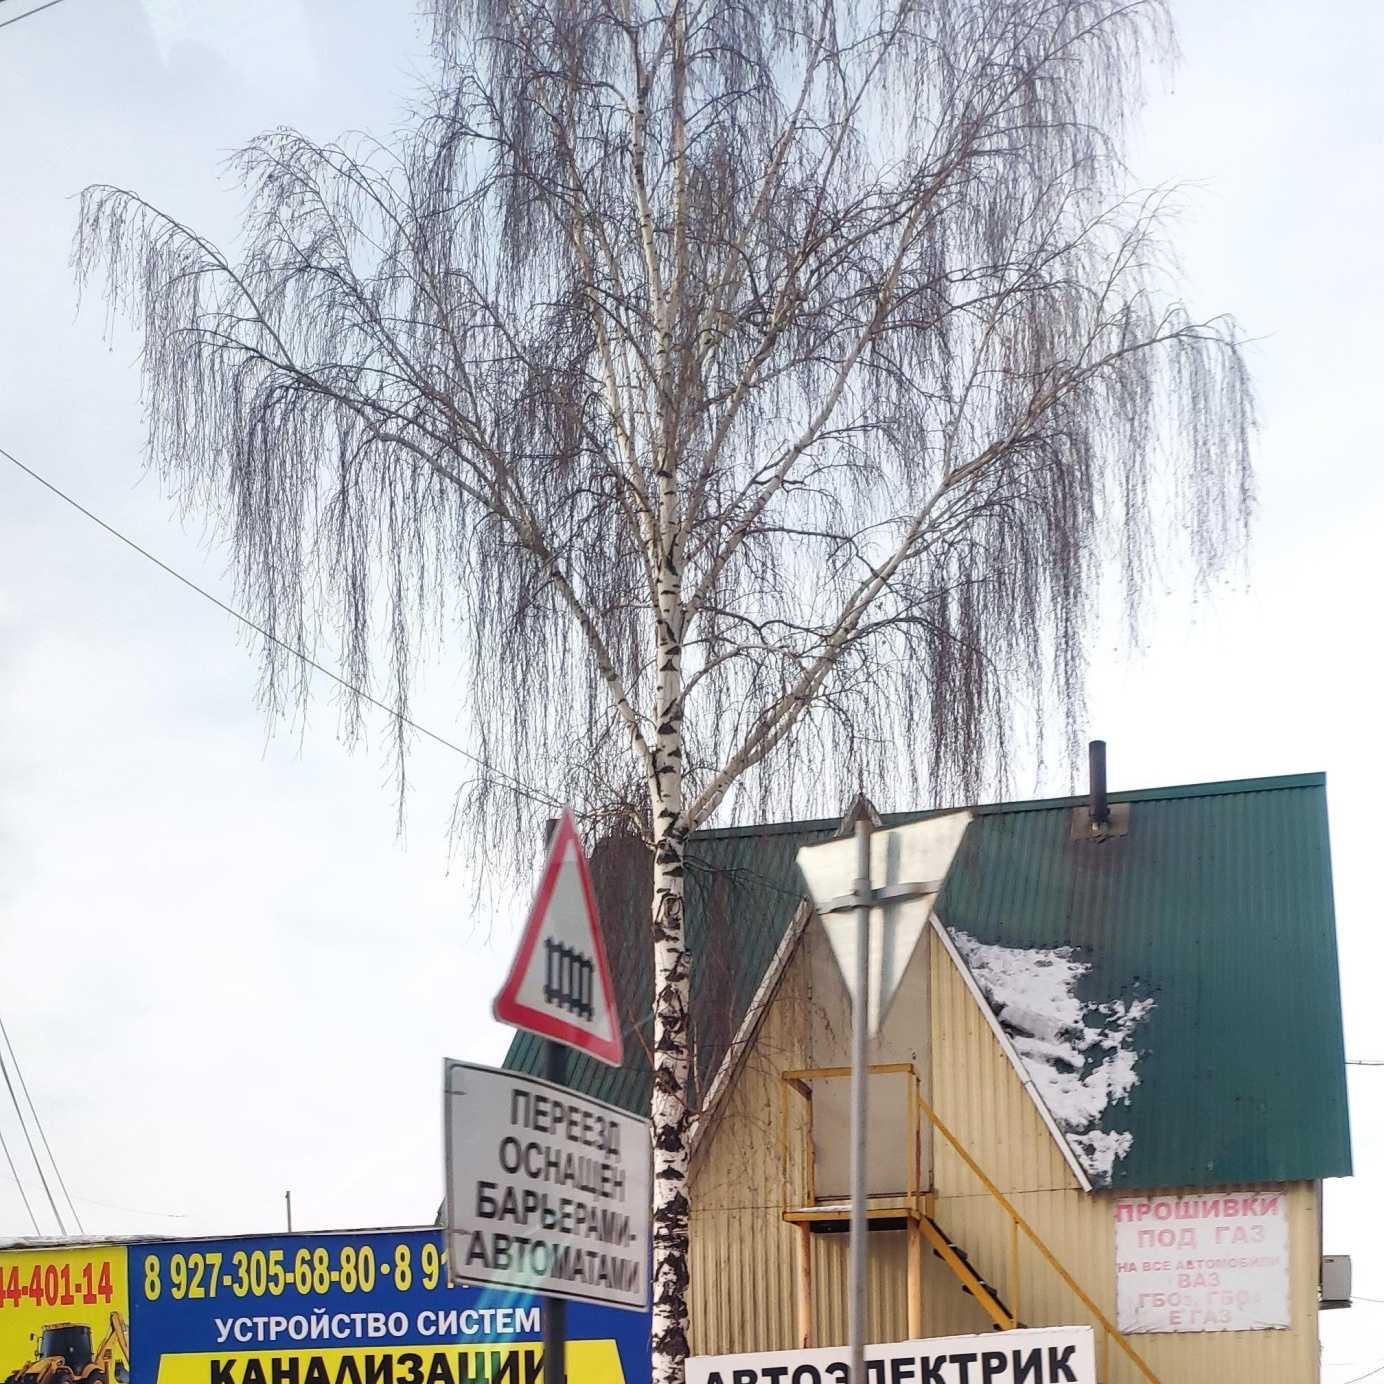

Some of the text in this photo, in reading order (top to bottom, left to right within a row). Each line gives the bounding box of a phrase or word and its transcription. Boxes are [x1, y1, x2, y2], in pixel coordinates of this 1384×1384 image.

[510, 1088, 622, 1163] ПЕРЕЕЗД
[500, 1136, 626, 1203] ОСНАЩЕН
[475, 1180, 637, 1248] БАРЬЕРАМИ-
[1114, 1198, 1279, 1223] ПРОШИВКИ
[1138, 1224, 1265, 1249] ПОД ГАЗ
[144, 1254, 161, 1301] 8
[464, 1230, 640, 1294] АВТОМАТАМИ
[1117, 1261, 1137, 1273] НА
[1143, 1260, 1171, 1272] ВСЕ
[1177, 1272, 1220, 1288] ВАЗ
[214, 1307, 541, 1343] УСТРОЙСТВО СИСТЕМ
